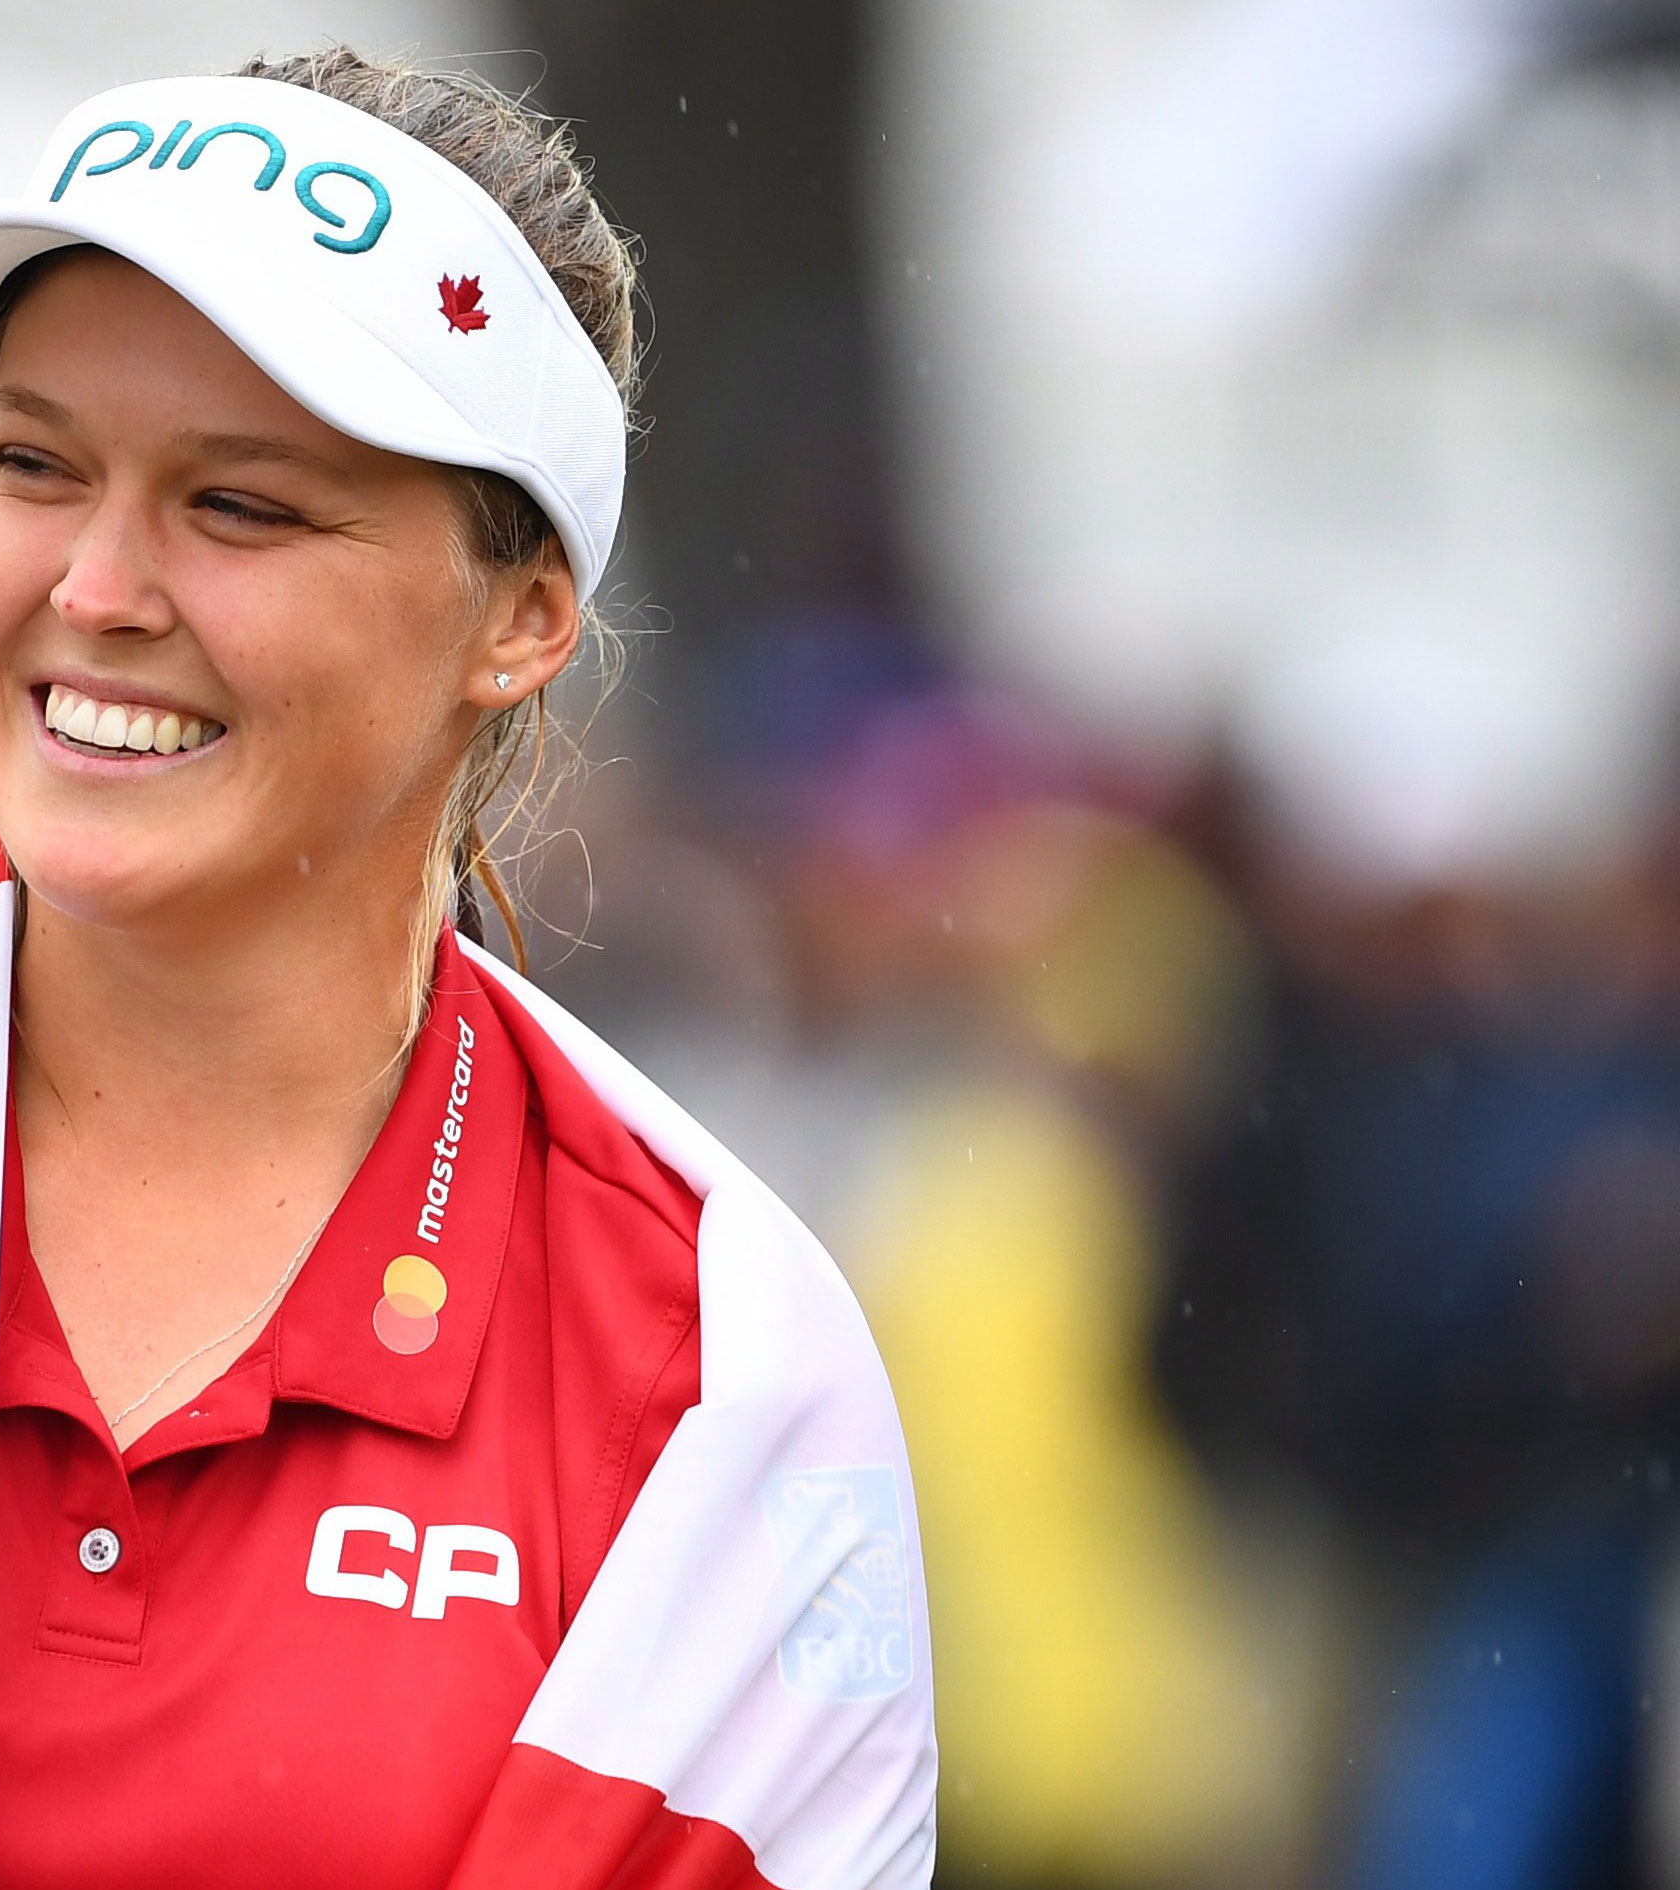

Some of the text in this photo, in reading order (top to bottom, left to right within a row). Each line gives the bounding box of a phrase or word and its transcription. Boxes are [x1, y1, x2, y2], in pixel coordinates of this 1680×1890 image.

[50, 119, 392, 255] ping
[416, 1015, 475, 1244] mastercard
[305, 1505, 521, 1620] CP
